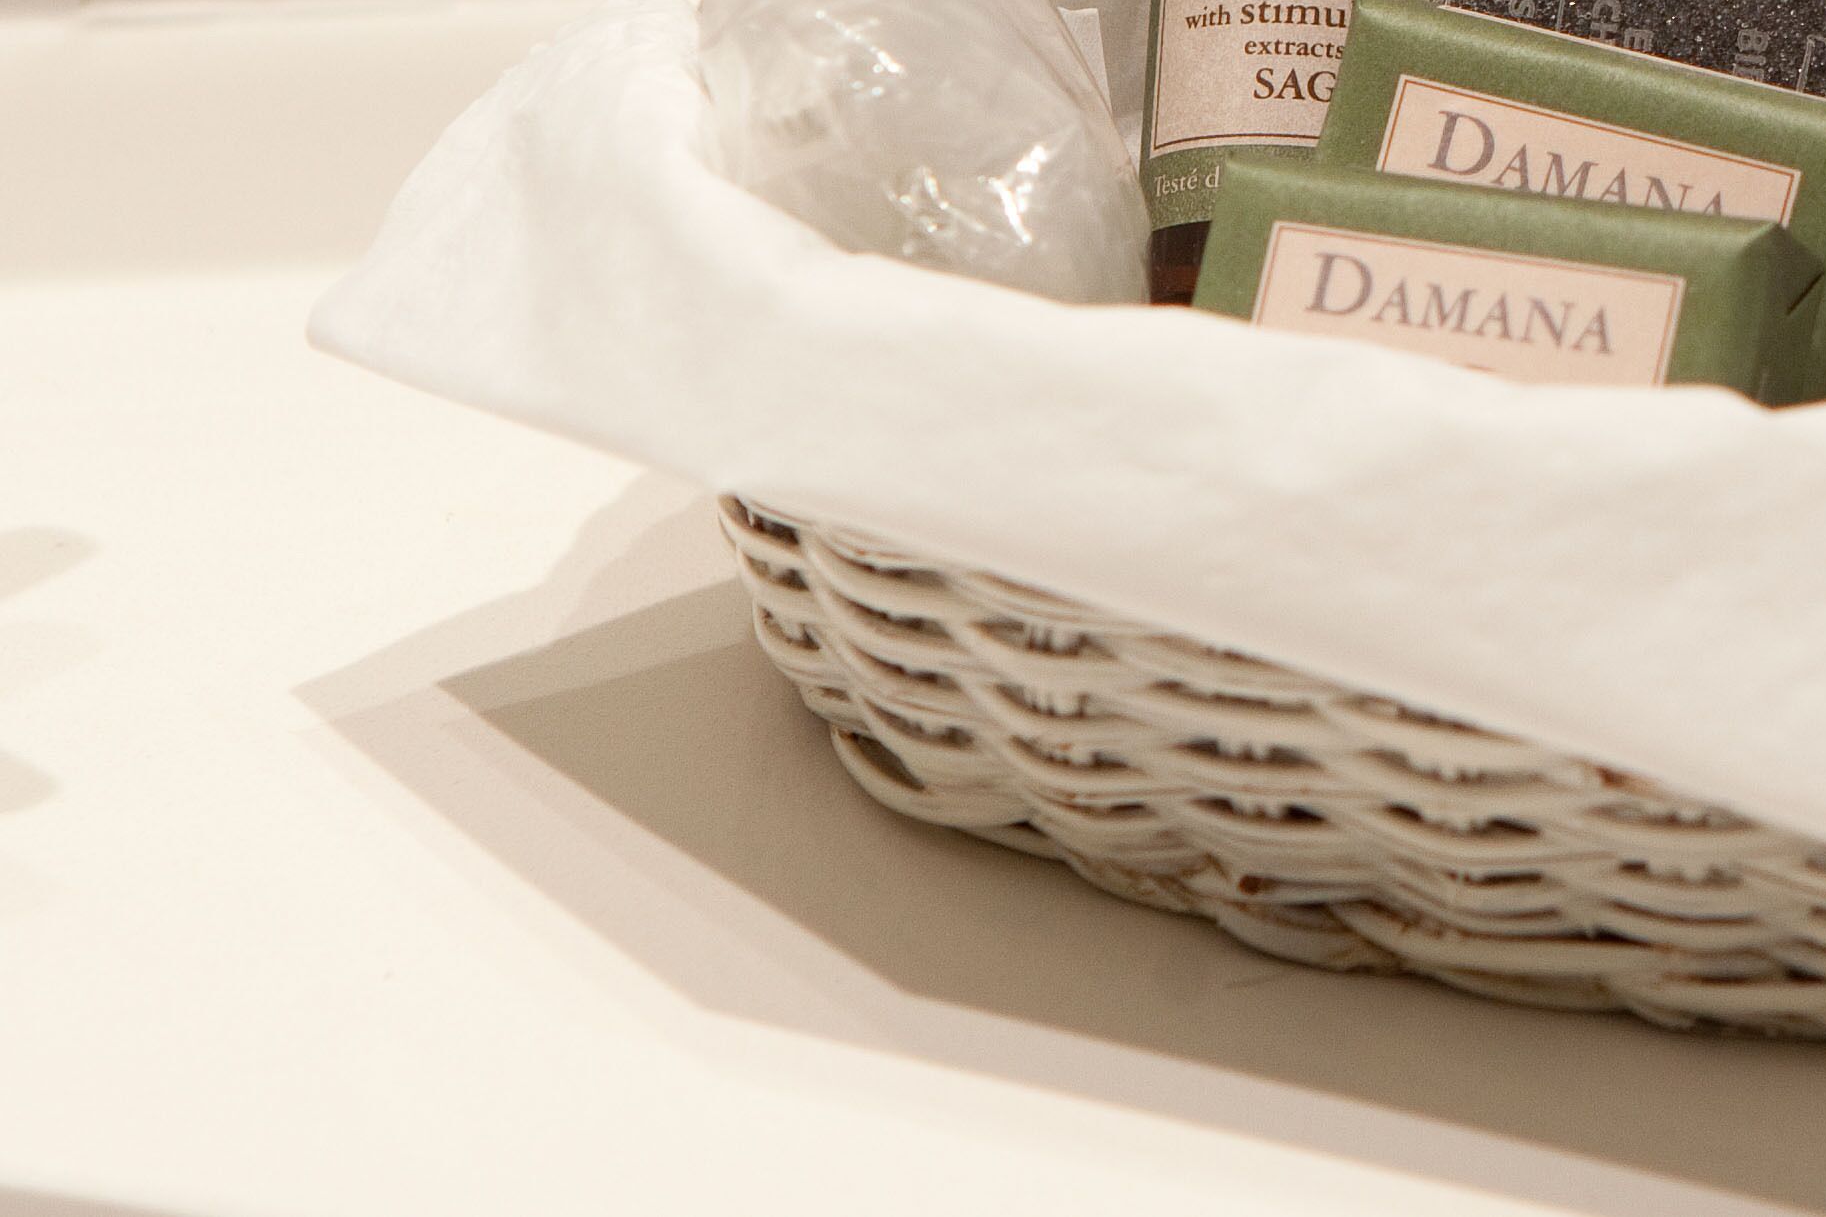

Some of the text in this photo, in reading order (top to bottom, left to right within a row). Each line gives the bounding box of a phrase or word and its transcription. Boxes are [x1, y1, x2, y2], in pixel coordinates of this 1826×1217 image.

[1185, 4, 1231, 30] with
[1244, 39, 1345, 60] extracts
[1253, 67, 1337, 103] SAG
[1153, 167, 1199, 197] Testé
[1304, 252, 1614, 356] DAMANA
